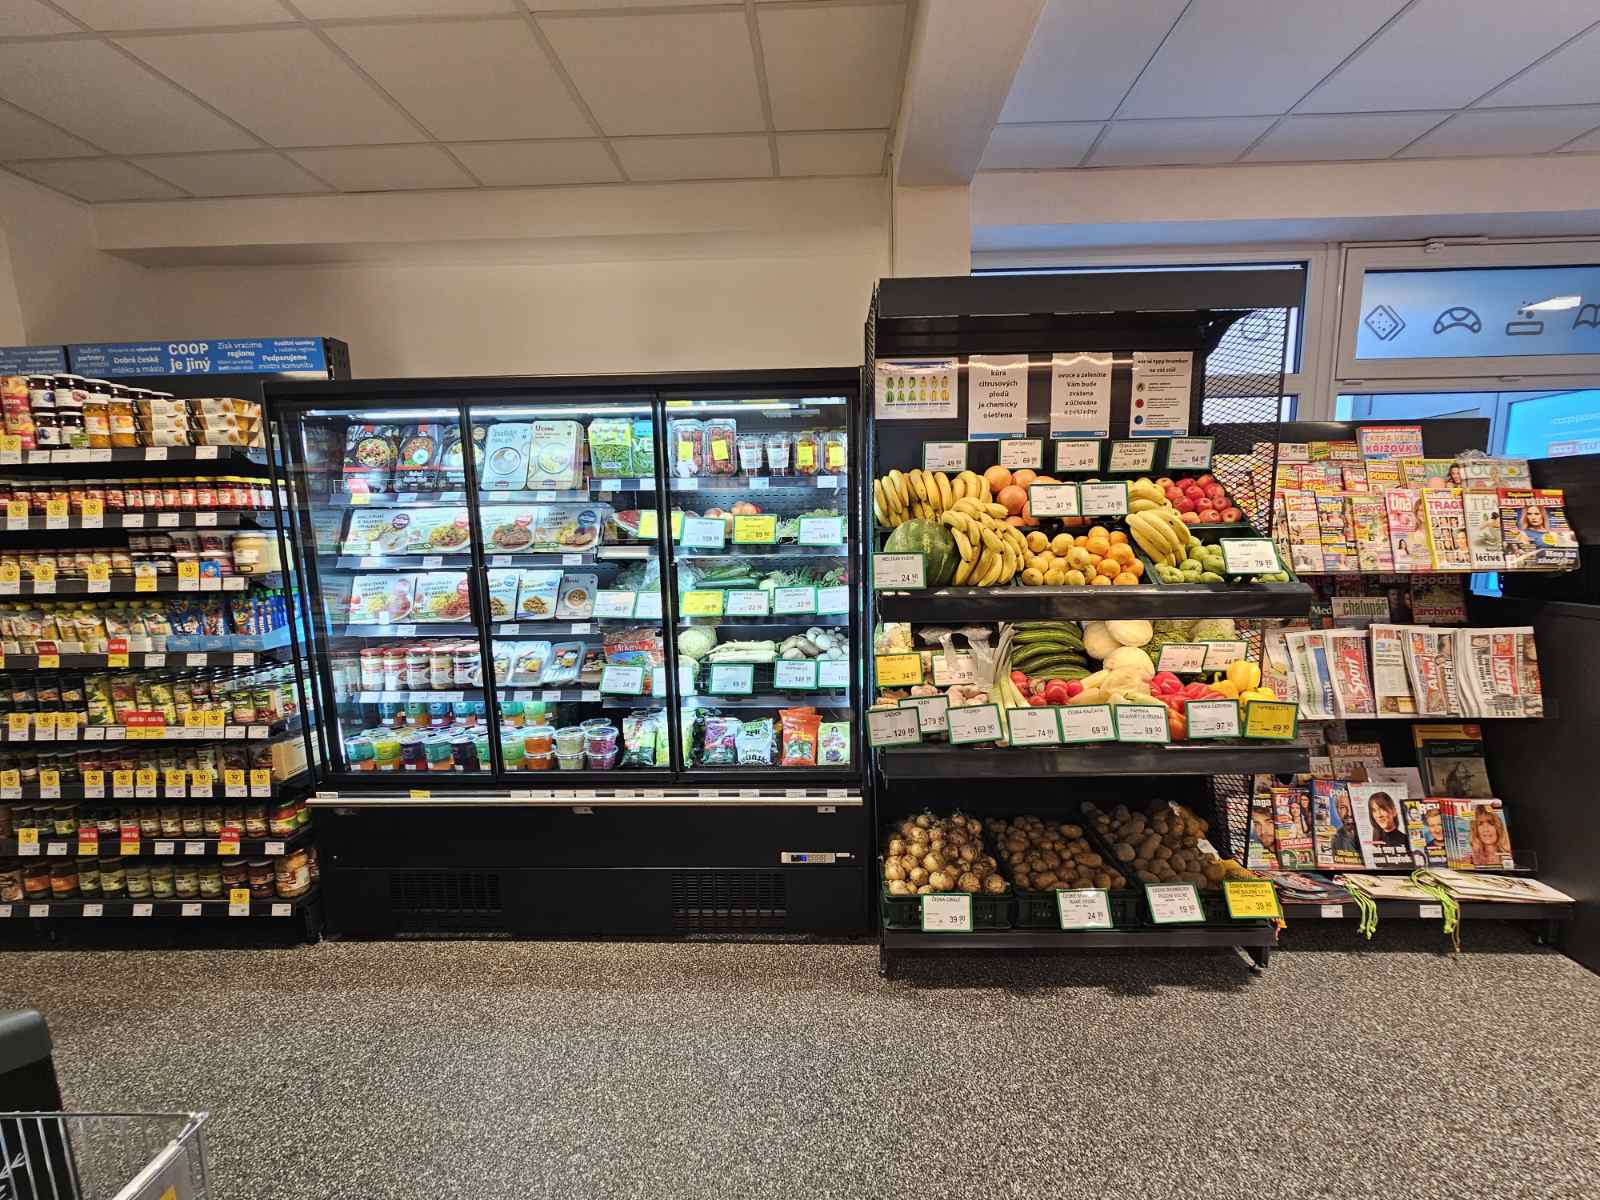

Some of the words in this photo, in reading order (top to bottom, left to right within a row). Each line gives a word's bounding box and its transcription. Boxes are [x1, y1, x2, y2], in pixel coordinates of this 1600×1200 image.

[168, 343, 208, 356] COOP
[227, 350, 255, 359] regionu
[170, 358, 182, 373] je
[185, 356, 211, 372] jiný
[979, 379, 1018, 389] citrusových
[988, 390, 1009, 400] plodů
[986, 400, 1018, 409] chemicky
[983, 410, 1013, 419] ošetřena
[1494, 657, 1514, 695] BLESK
